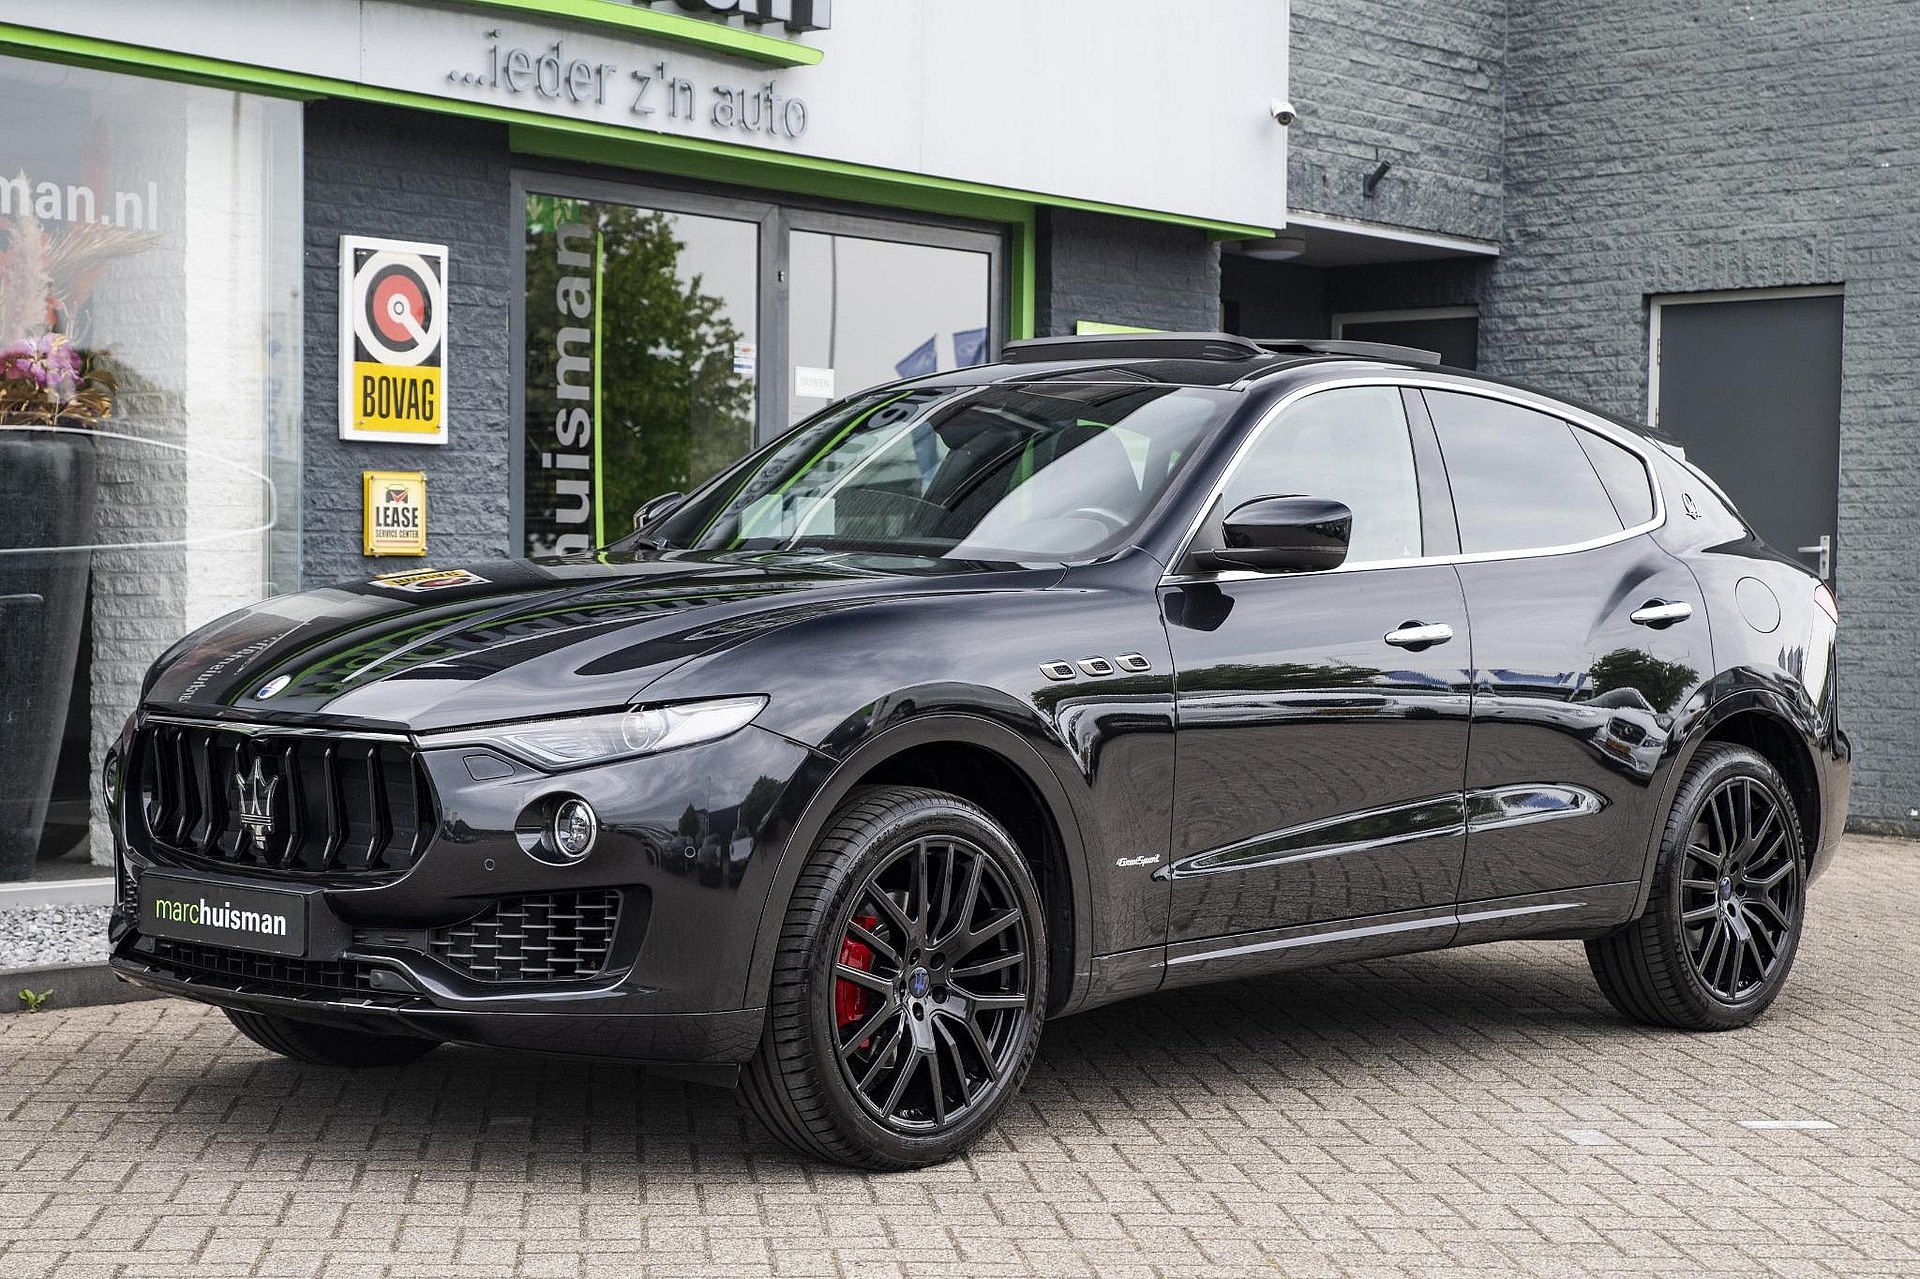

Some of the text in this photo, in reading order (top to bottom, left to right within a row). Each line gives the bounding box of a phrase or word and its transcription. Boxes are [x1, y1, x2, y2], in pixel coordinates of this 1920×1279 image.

[630, 61, 698, 121] z'n
[712, 79, 809, 139] auto
[362, 375, 435, 422] BOVAG
[375, 506, 419, 528] LEASE
[375, 529, 419, 538] SERVICE CENTER
[156, 898, 286, 936] marchuisman
